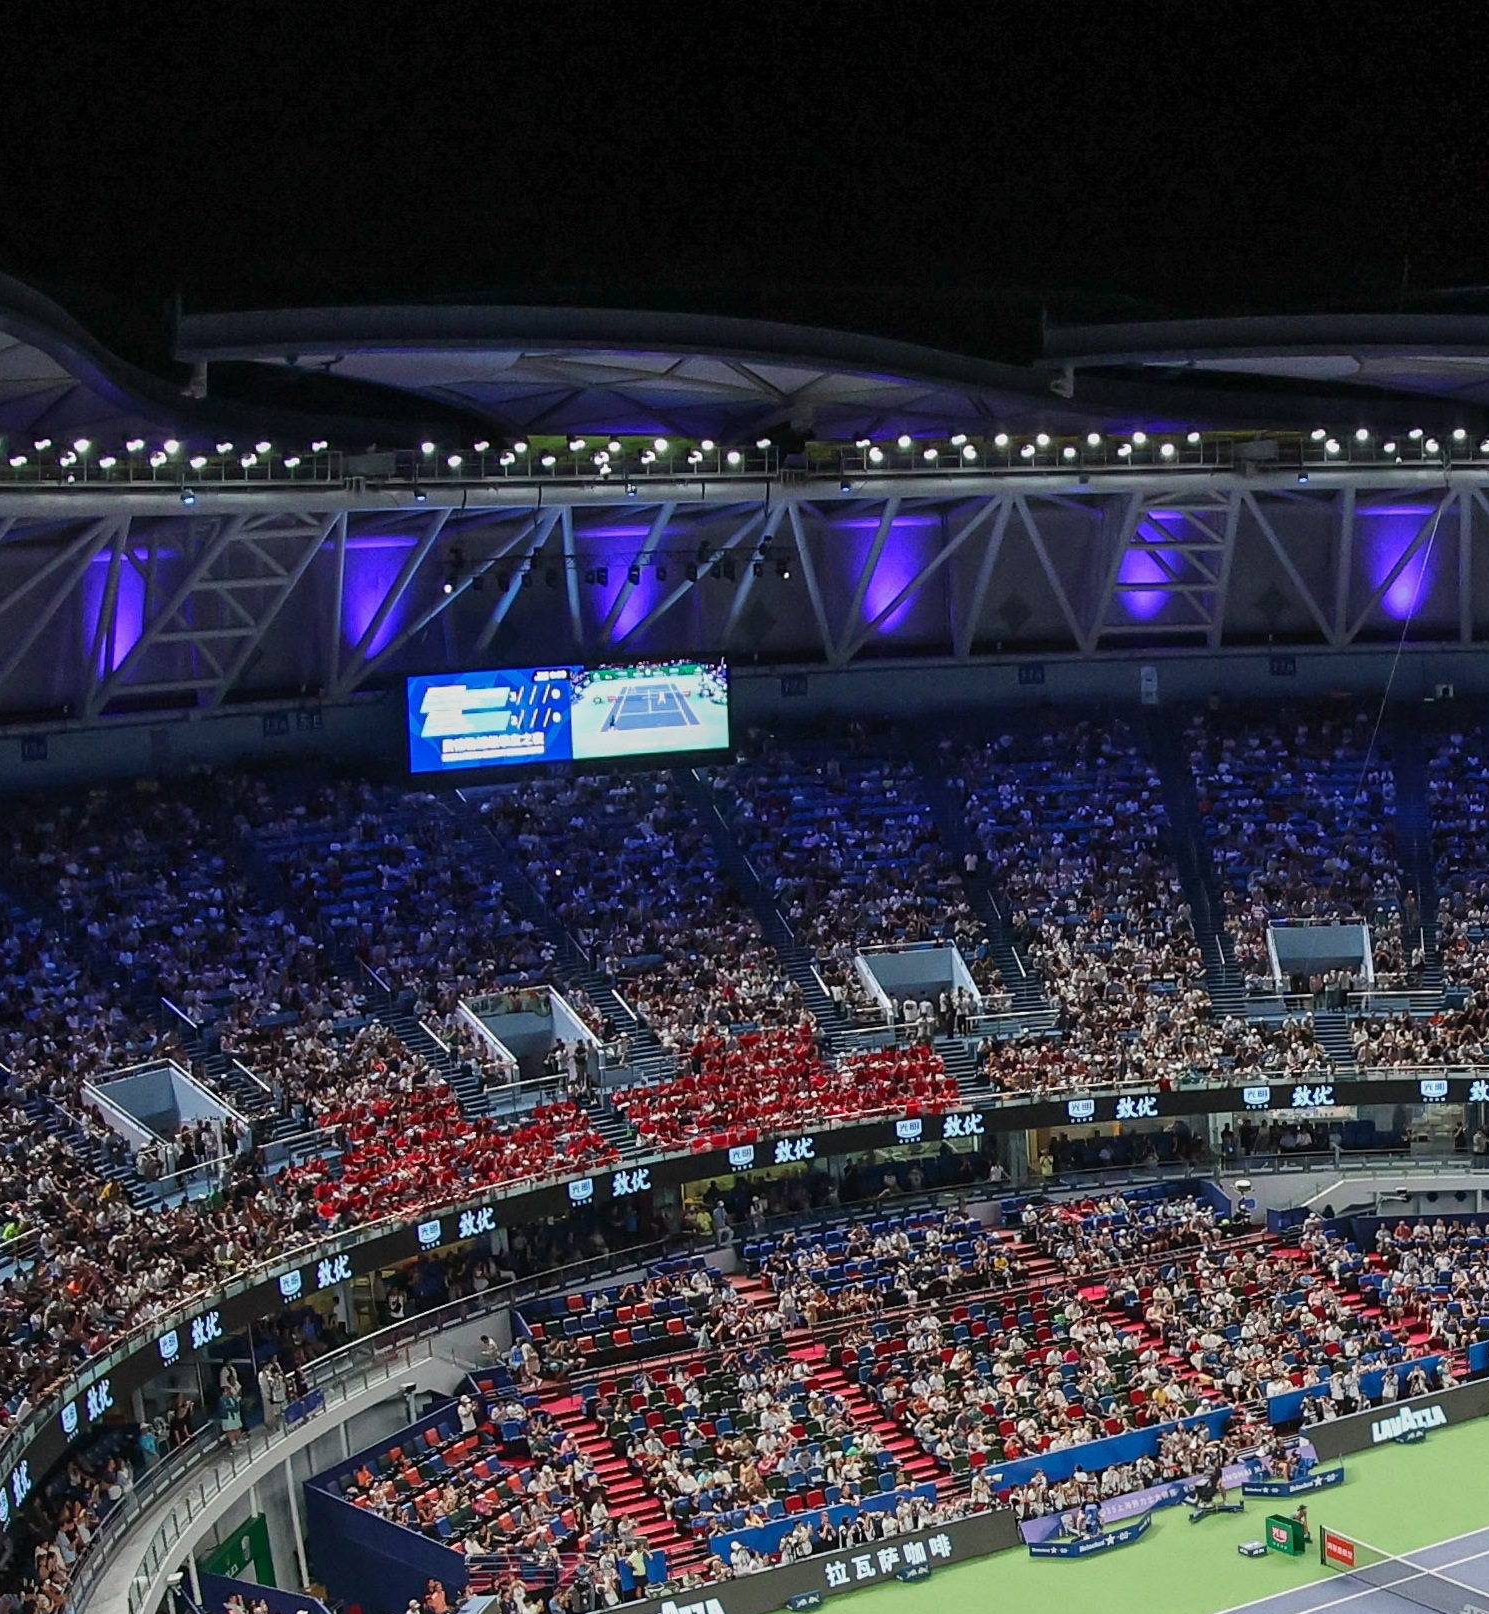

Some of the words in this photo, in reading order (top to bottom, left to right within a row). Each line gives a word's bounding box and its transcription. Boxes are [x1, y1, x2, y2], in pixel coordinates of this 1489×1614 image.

[1116, 1096, 1158, 1118] 致优
[1292, 1085, 1336, 1108] 致优
[944, 1114, 984, 1139] 致优
[775, 1138, 814, 1163] 致优
[613, 1167, 650, 1196] 致优
[459, 1208, 495, 1238] 致优
[316, 1254, 352, 1288] 致优
[191, 1312, 221, 1348] 致优
[1371, 1405, 1448, 1444] LAVAZZA
[825, 1532, 953, 1589] 拉瓦萨咖啡
